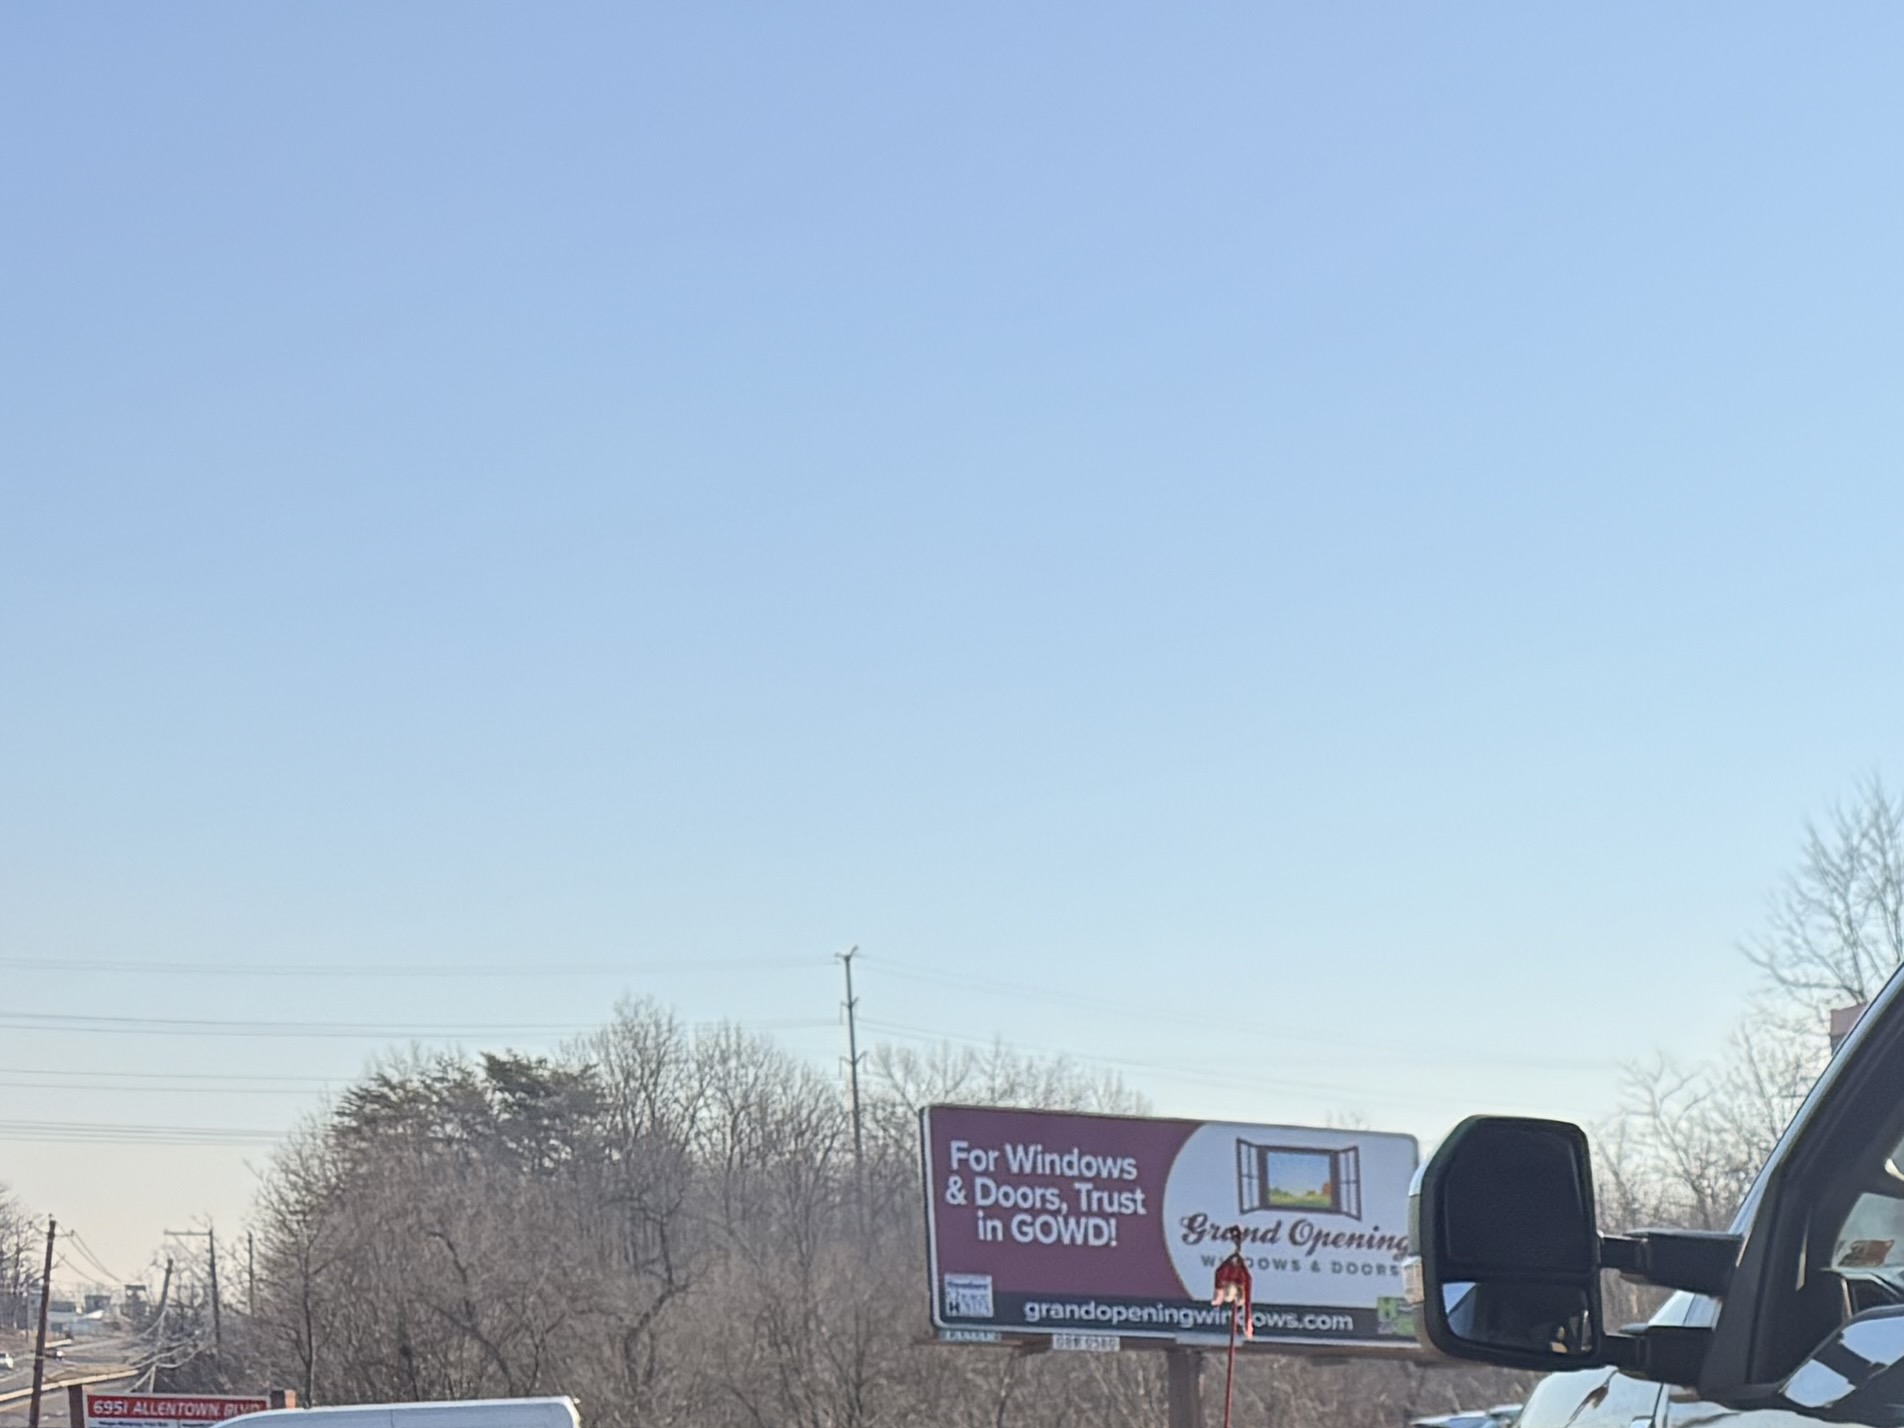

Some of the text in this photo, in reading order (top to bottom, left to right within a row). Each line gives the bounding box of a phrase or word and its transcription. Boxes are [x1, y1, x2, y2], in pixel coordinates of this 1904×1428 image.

[950, 1140, 1138, 1180] For Windows
[946, 1175, 1147, 1215] & Doors, Trust
[977, 1210, 1118, 1247] in GOWD!
[1288, 1218, 1409, 1262] Opening
[1310, 1259, 1321, 1273] &
[1332, 1261, 1400, 1277] DOORS
[93, 1401, 127, 1415] 6951
[132, 1402, 220, 1417] ALLENTOWN
